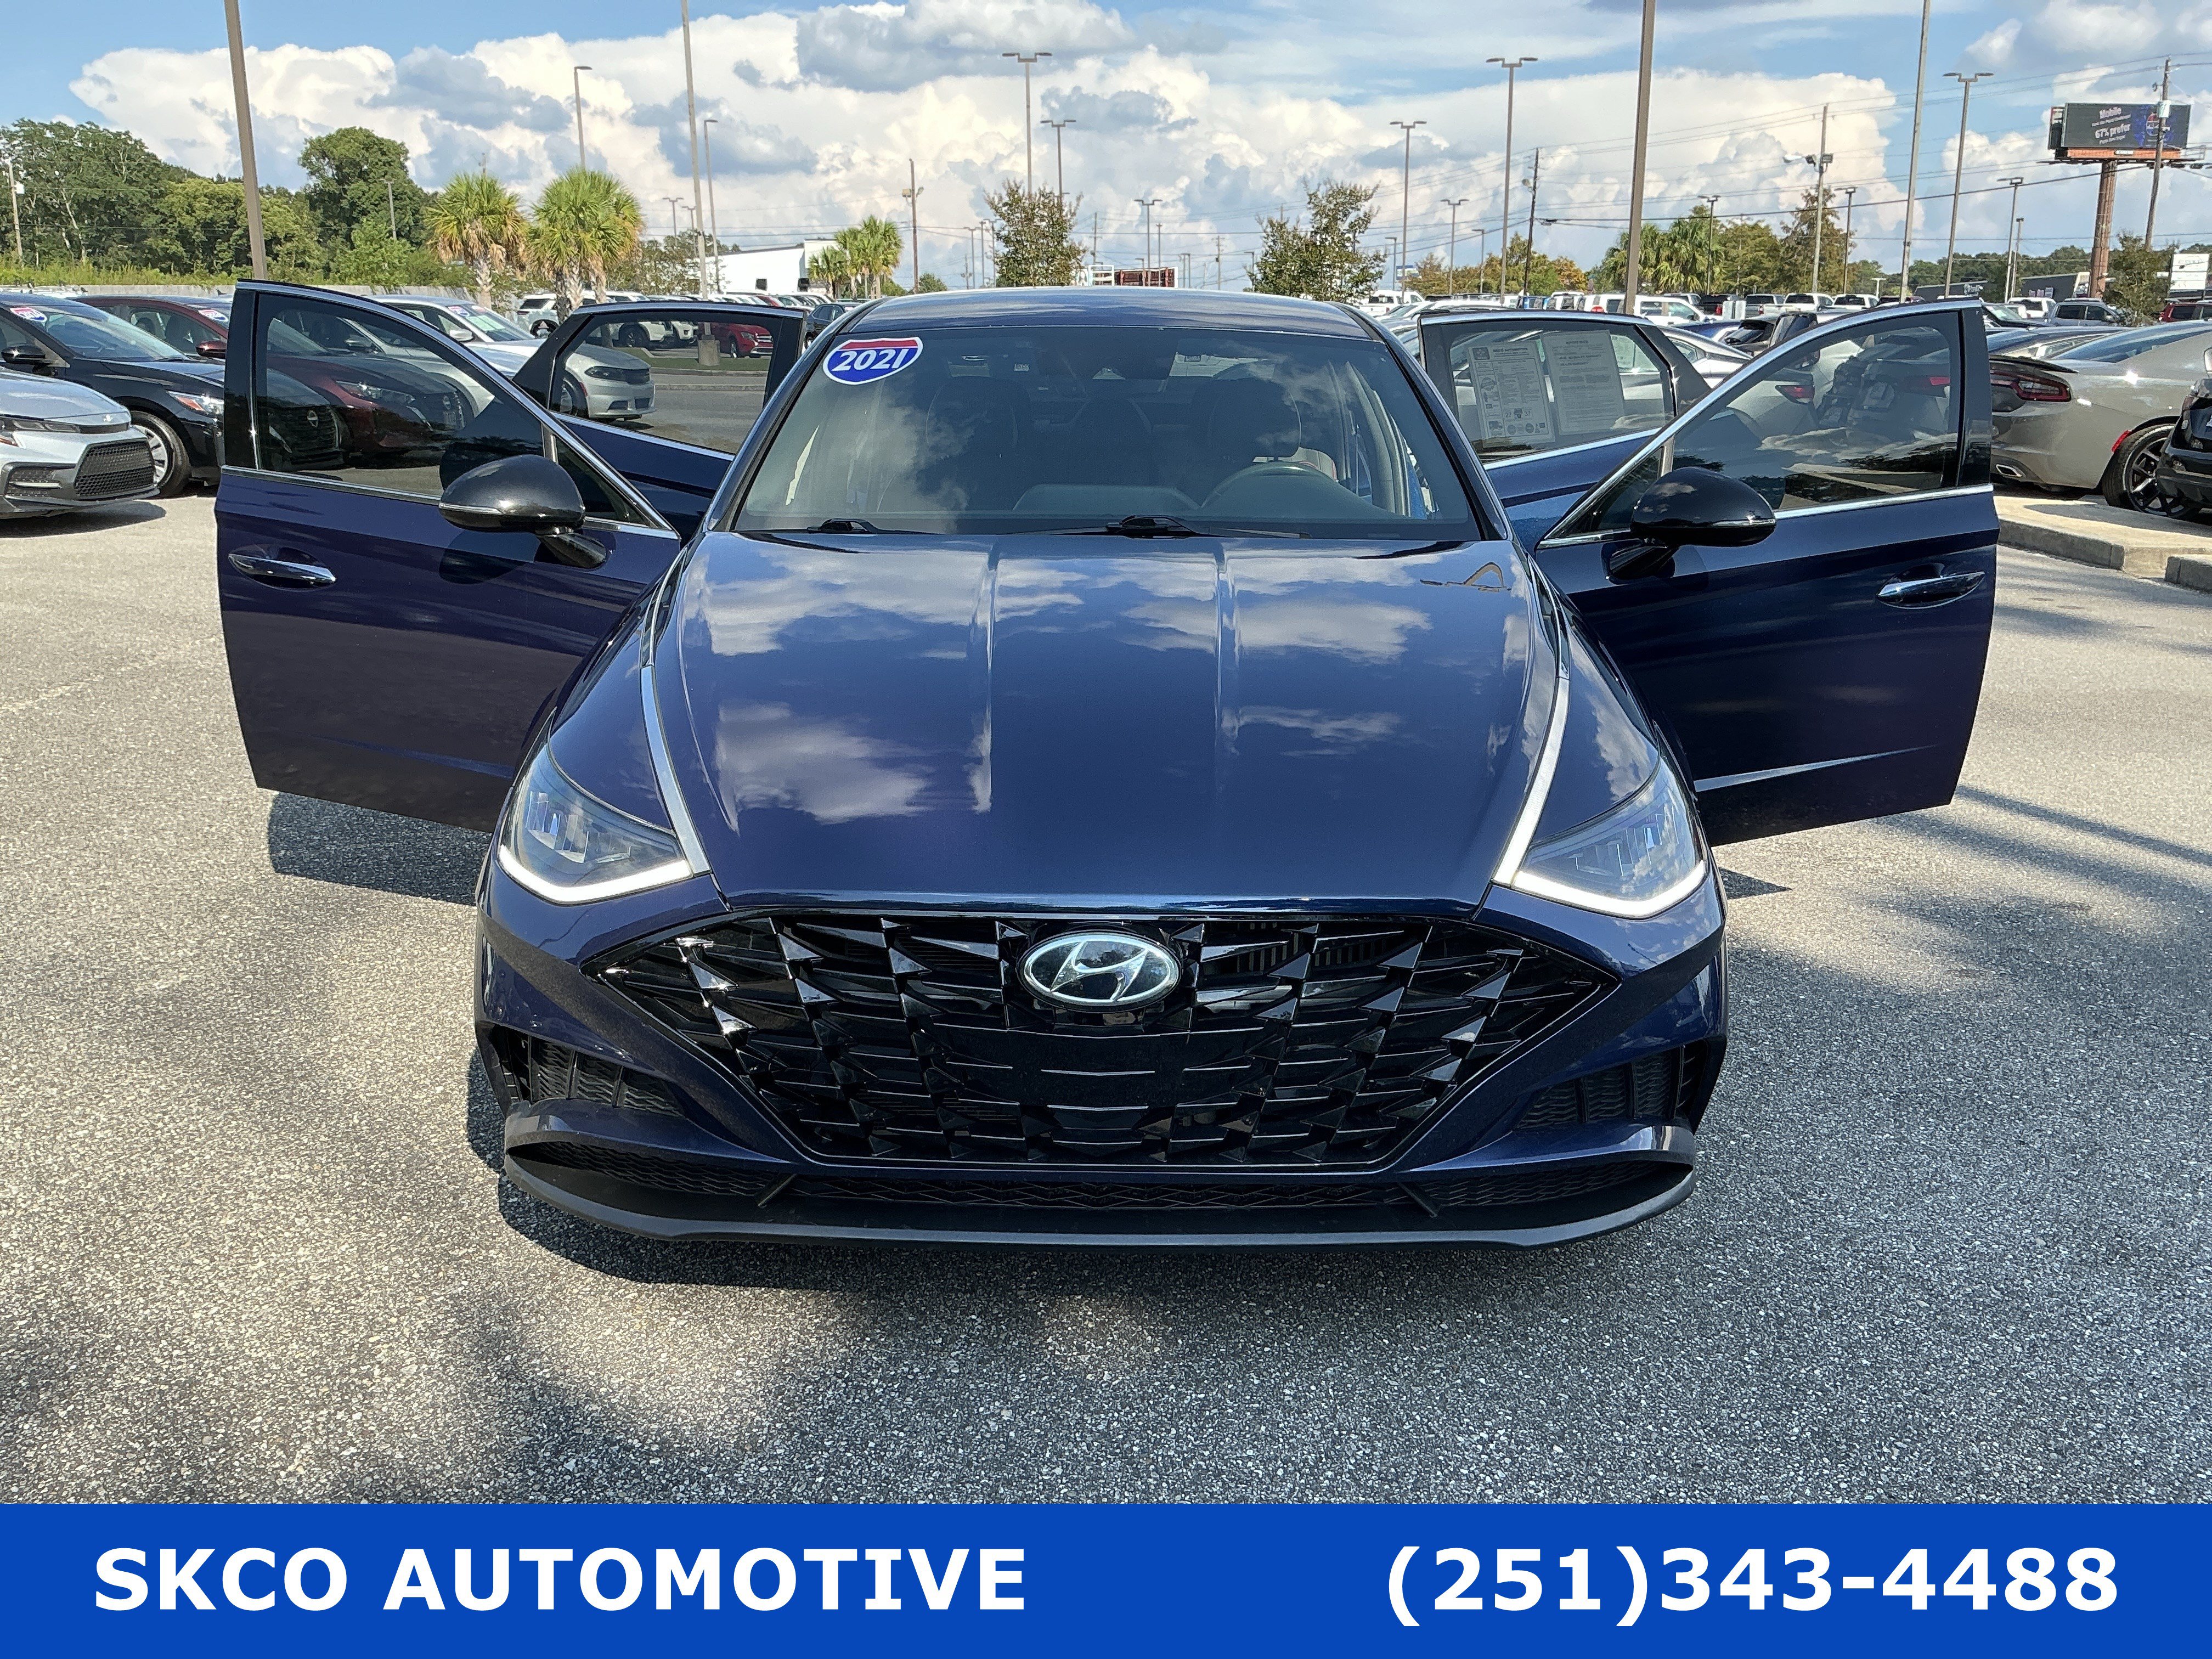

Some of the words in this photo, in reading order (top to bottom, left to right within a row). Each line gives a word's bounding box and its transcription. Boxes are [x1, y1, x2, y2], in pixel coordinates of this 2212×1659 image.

[2095, 128, 2109, 139] 67%
[2109, 123, 2131, 137] prefer
[831, 348, 910, 371] 2021
